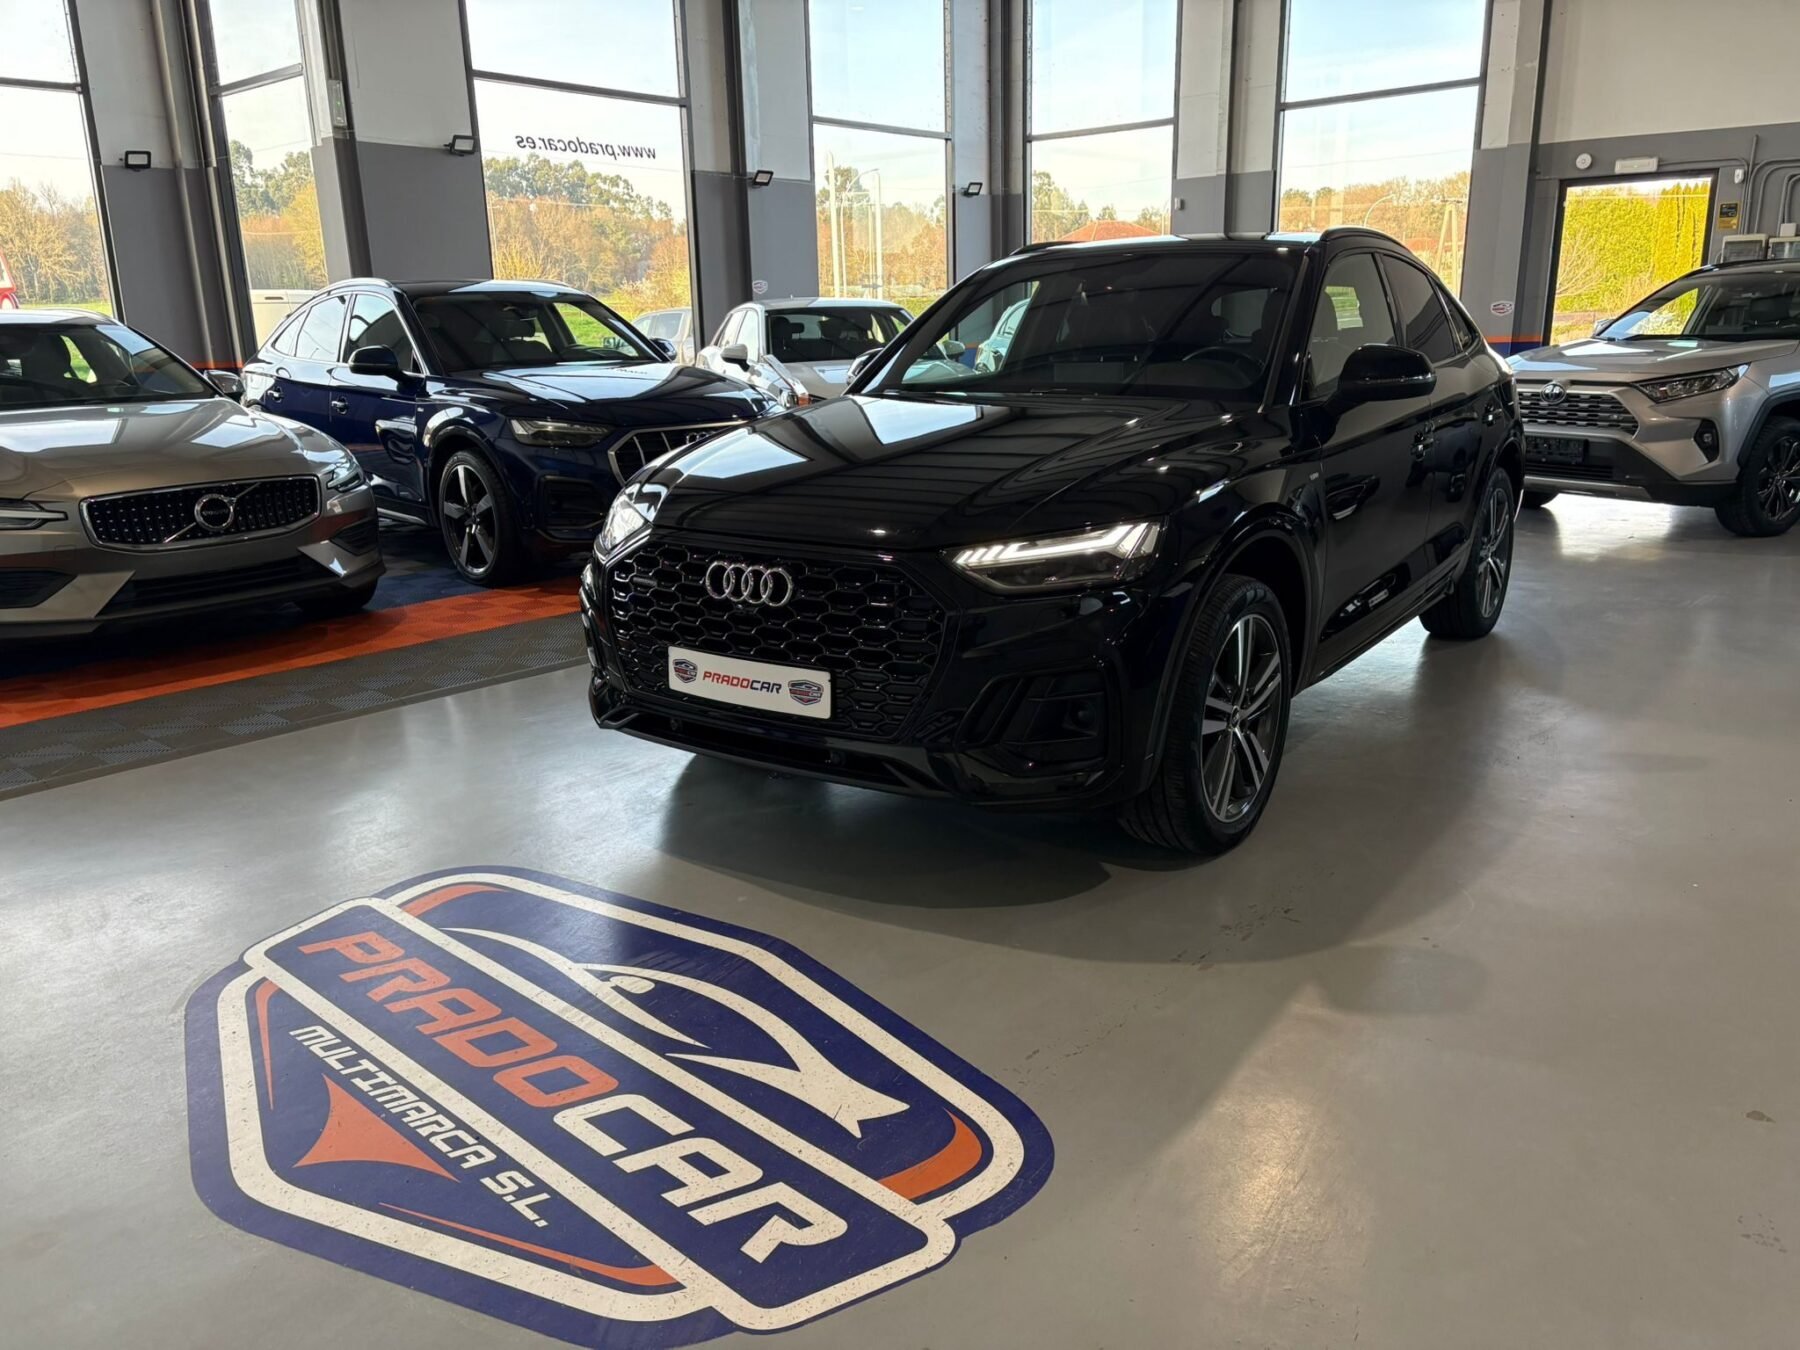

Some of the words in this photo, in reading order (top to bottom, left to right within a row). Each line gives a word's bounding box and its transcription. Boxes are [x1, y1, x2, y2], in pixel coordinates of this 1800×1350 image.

[702, 670, 782, 695] PRADOCAR
[288, 1025, 497, 1169] MULTIMARCA
[480, 1171, 551, 1228] S.L.
[298, 931, 848, 1264] PRADOCAR
